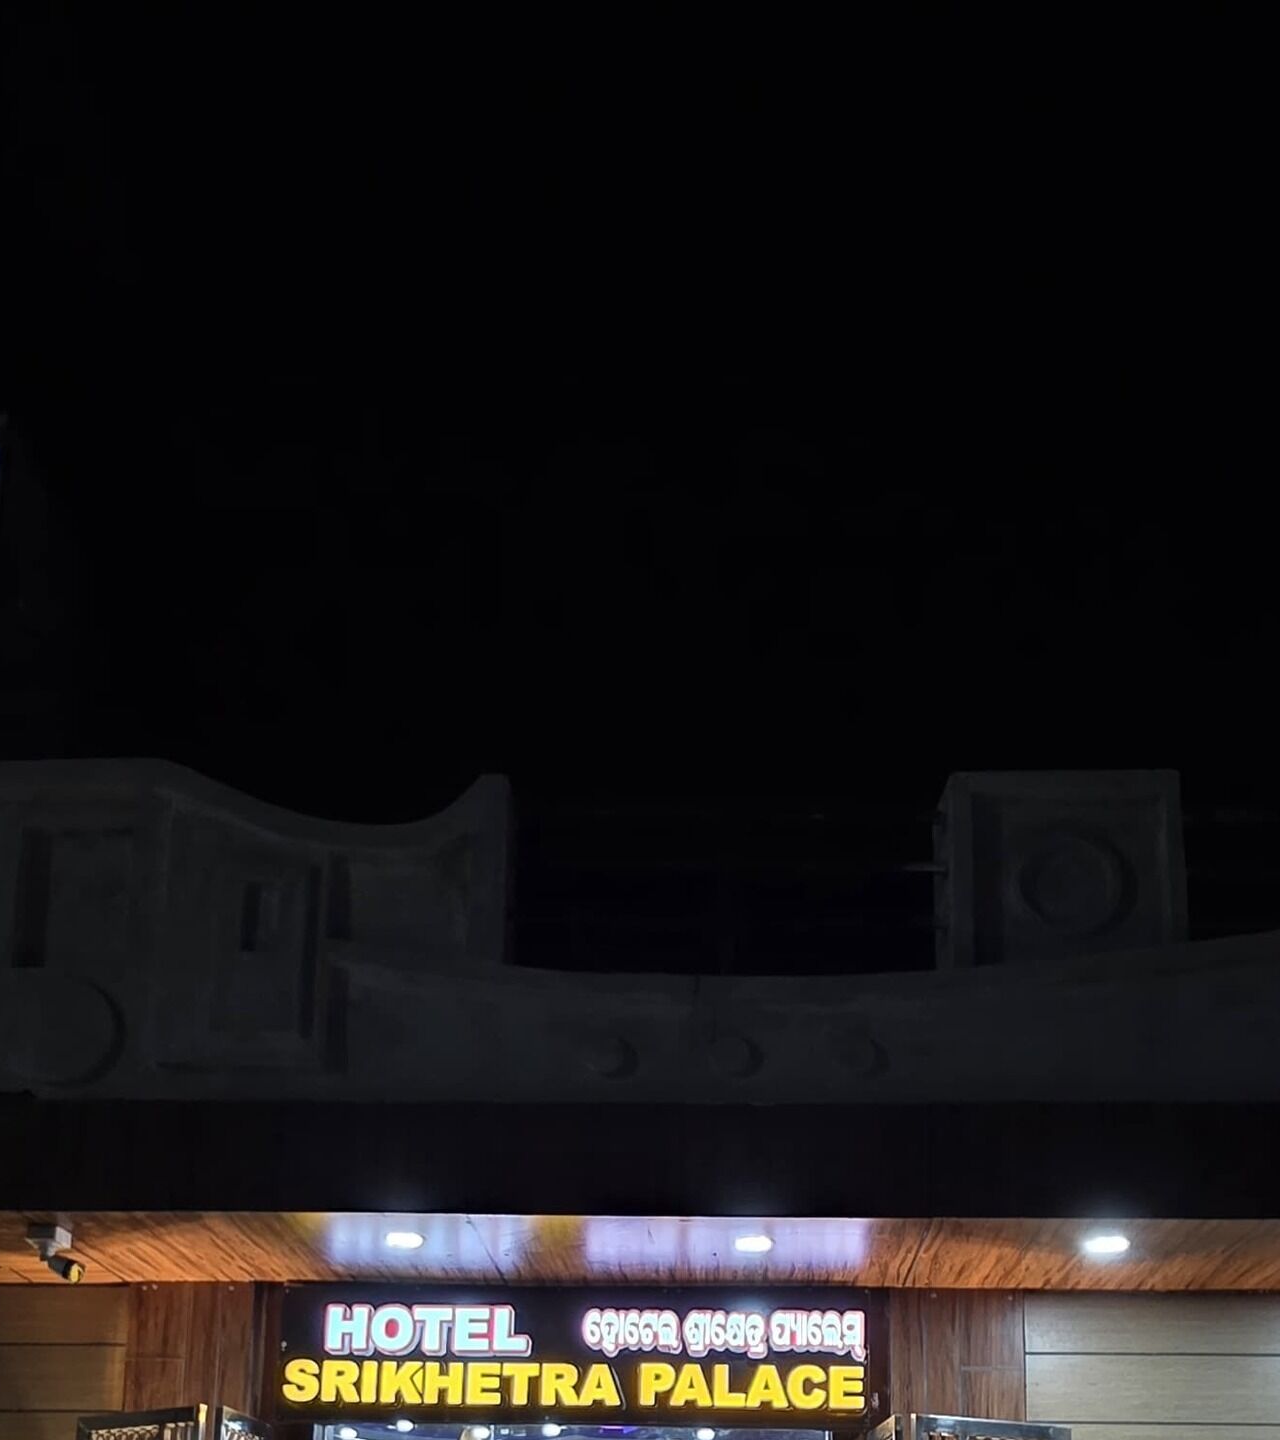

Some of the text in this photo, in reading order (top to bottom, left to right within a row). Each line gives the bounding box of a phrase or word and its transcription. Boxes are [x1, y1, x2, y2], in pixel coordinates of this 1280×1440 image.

[324, 1303, 532, 1356] HOTEL
[281, 1358, 866, 1412] SRIKHETRA PALACE
